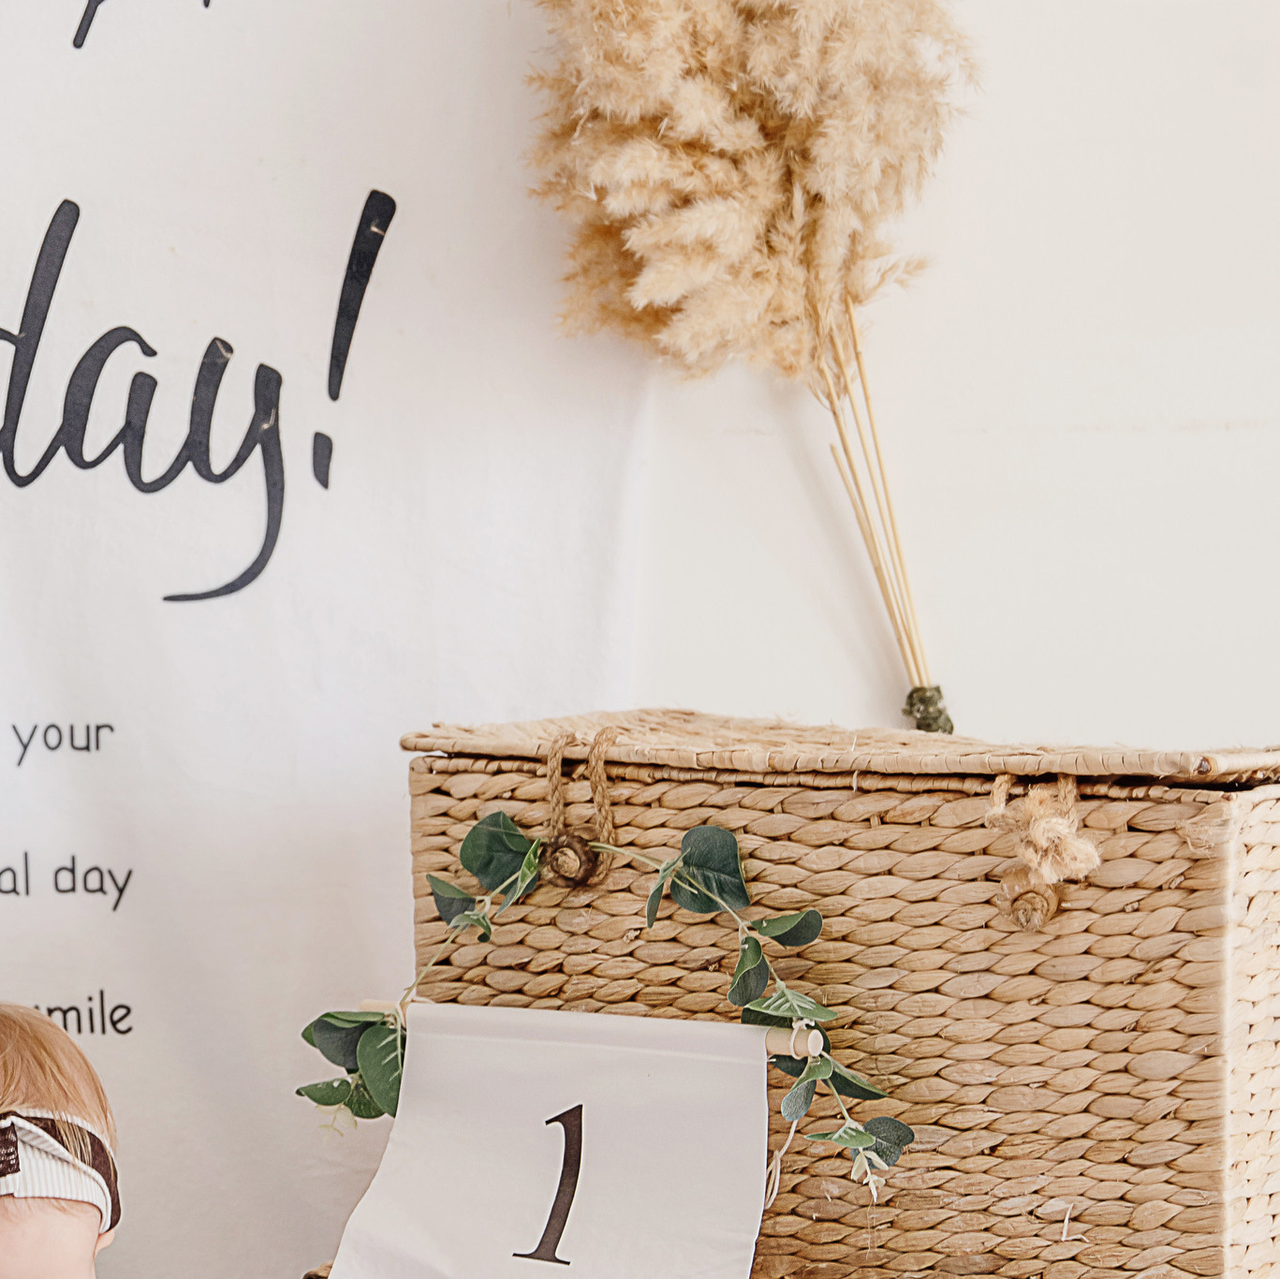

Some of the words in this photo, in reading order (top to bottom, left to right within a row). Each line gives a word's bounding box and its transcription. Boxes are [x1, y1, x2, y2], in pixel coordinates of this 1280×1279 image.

[12, 723, 115, 767] your
[53, 855, 134, 912] day
[32, 989, 133, 1036] mile
[512, 1103, 584, 1266] 1
